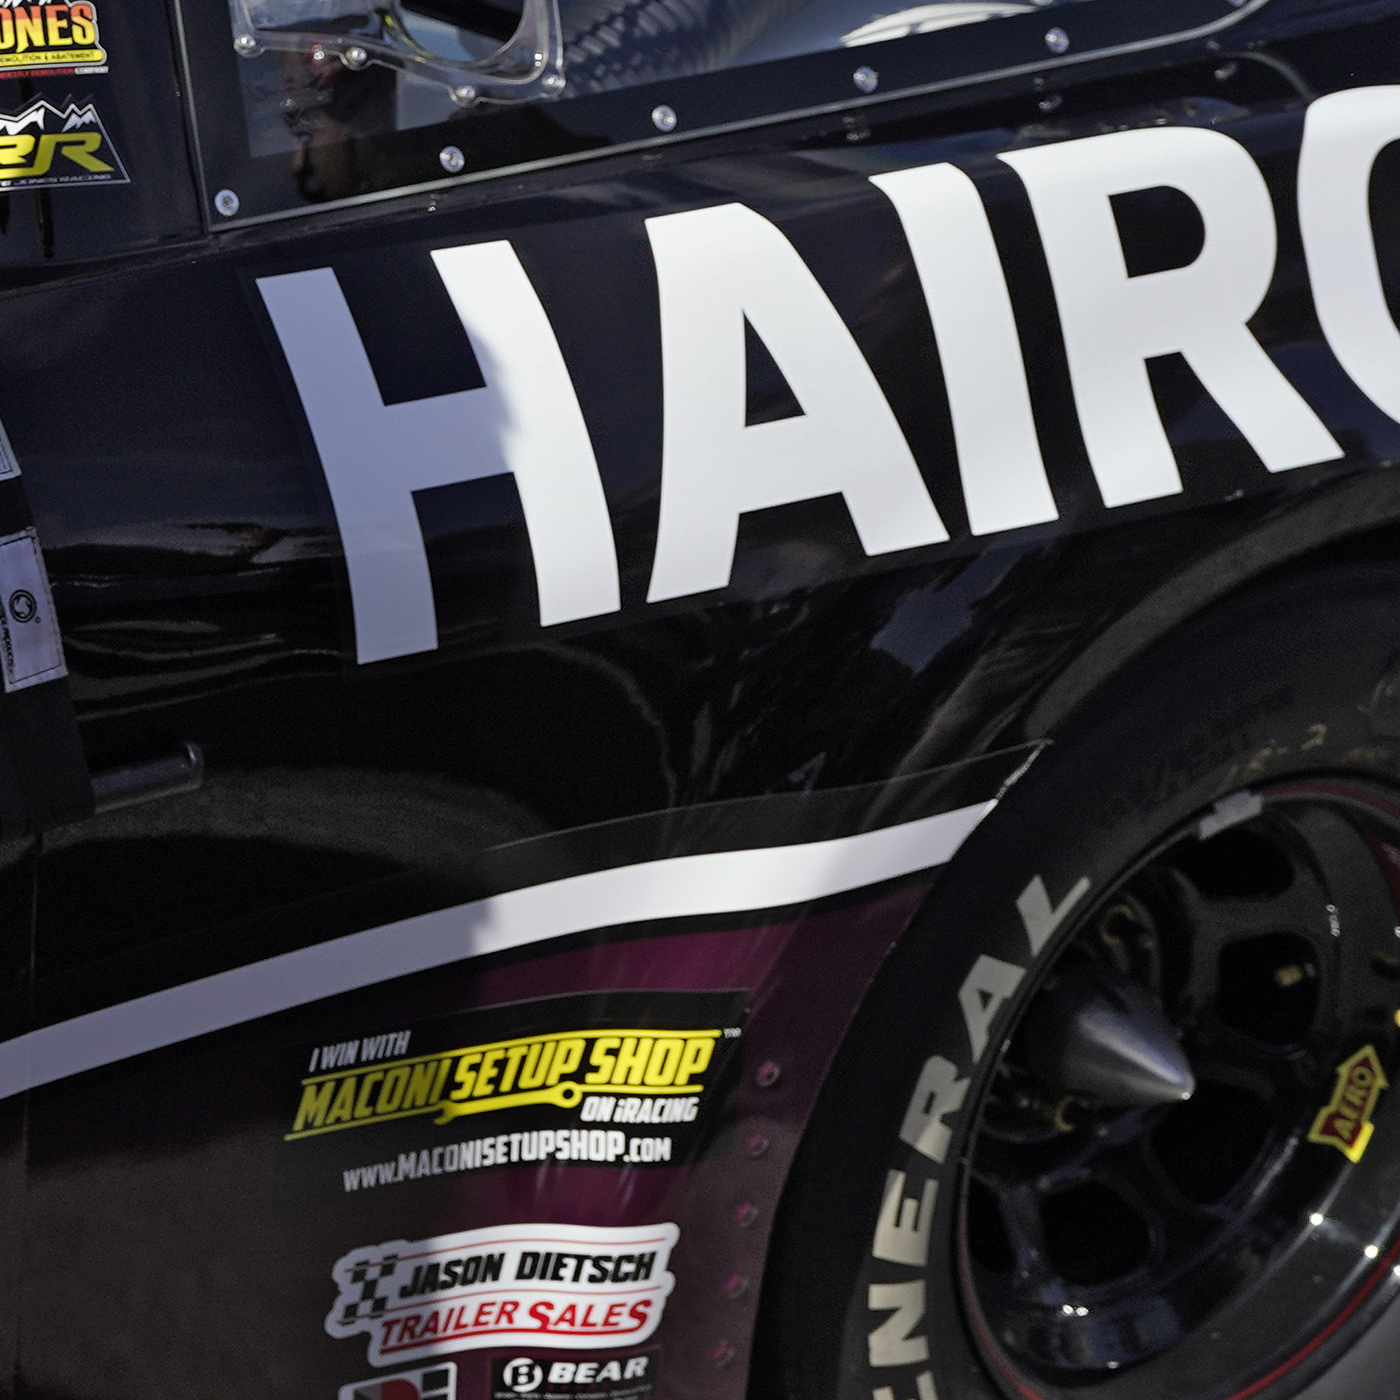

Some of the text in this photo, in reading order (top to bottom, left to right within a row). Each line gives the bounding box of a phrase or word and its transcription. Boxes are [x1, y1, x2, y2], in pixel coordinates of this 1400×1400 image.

[321, 1040, 359, 1071] WIN
[361, 1030, 412, 1064] WITH
[293, 1038, 715, 1133] MACONI SETUP SHOP
[580, 1096, 699, 1123] ON iRACING
[399, 1251, 656, 1298] JASON DIETSCH
[380, 1298, 652, 1347] TRAILER SALES
[547, 1356, 650, 1384] BEAR
